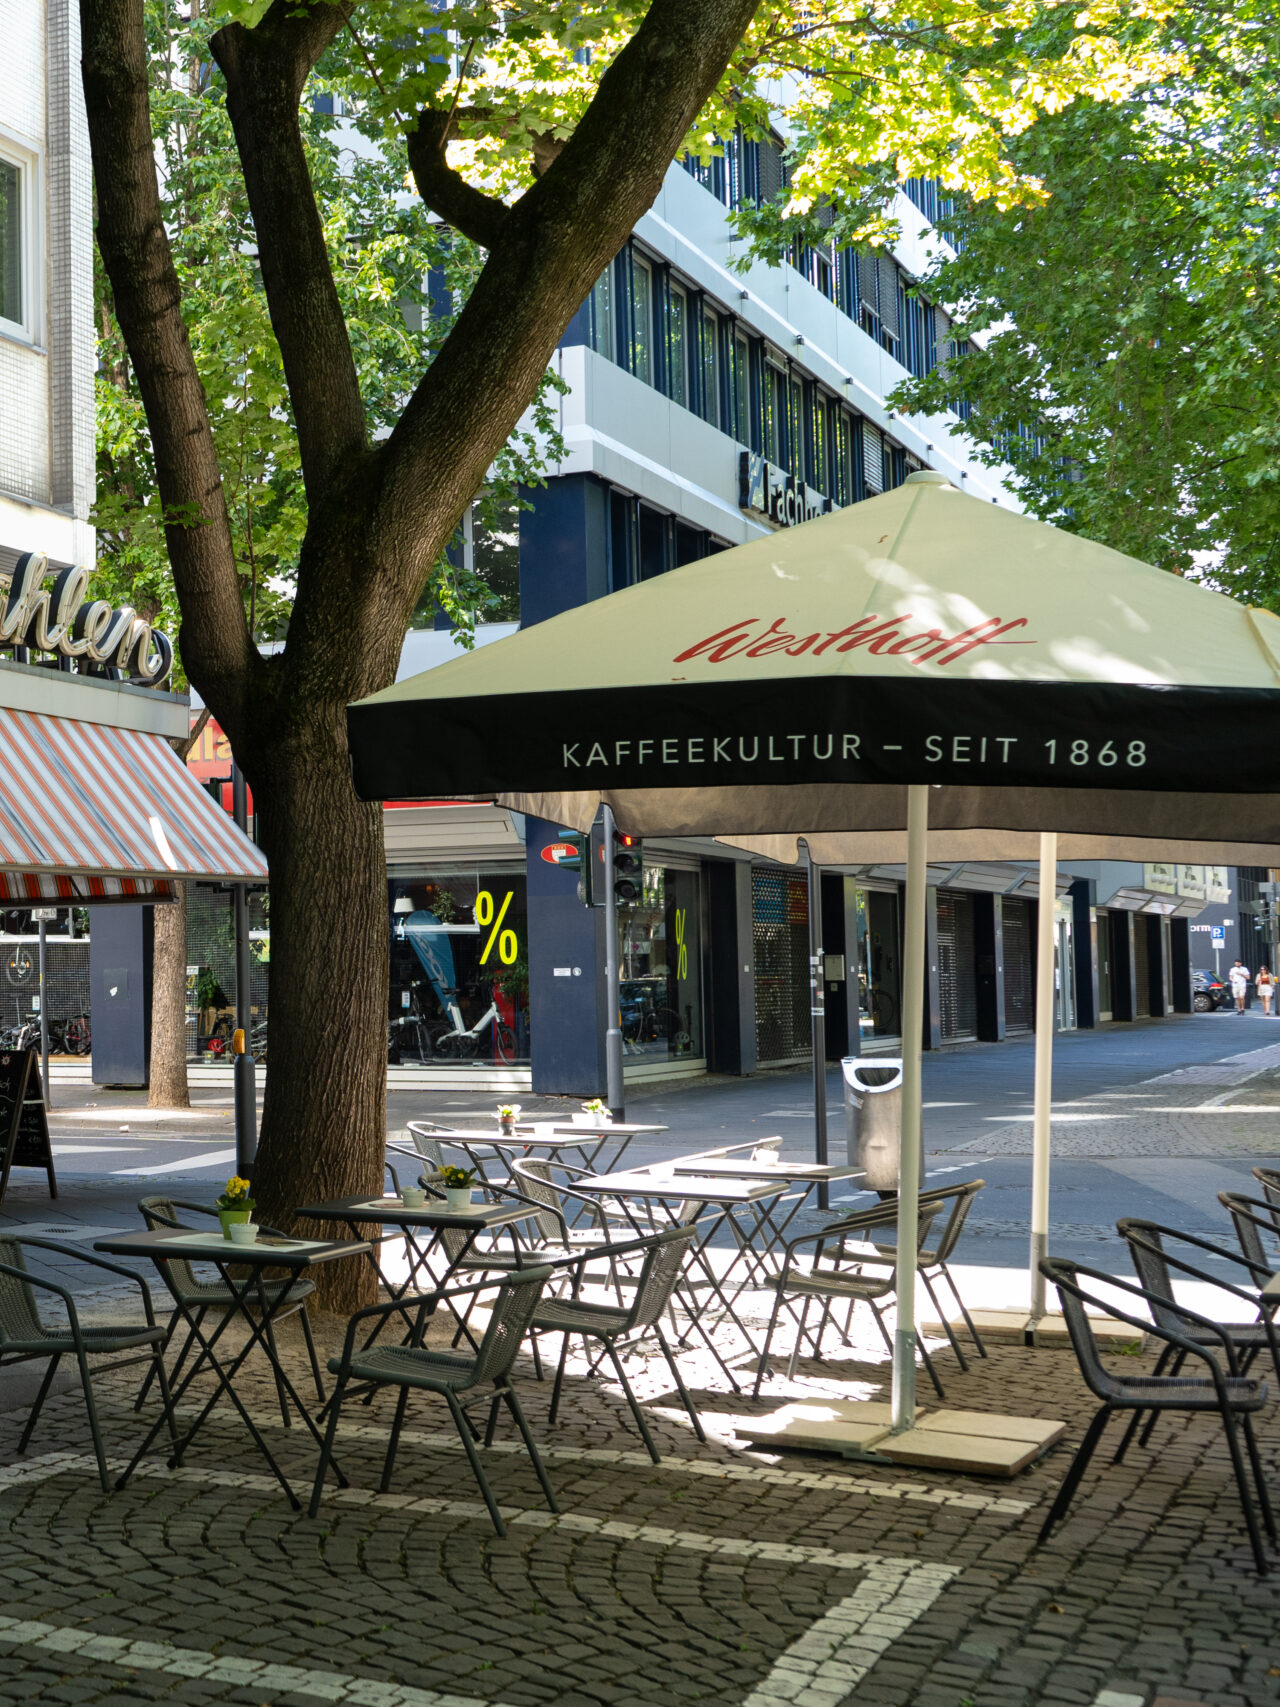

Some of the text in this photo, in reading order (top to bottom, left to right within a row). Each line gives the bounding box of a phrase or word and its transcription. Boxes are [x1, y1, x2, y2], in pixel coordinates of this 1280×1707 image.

[764, 462, 834, 526] Fachh
[672, 614, 1038, 668] Westhoff
[561, 732, 861, 769] KAFFEEKULTUR
[923, 734, 1019, 765] SEIT
[1044, 738, 1149, 768] 1868
